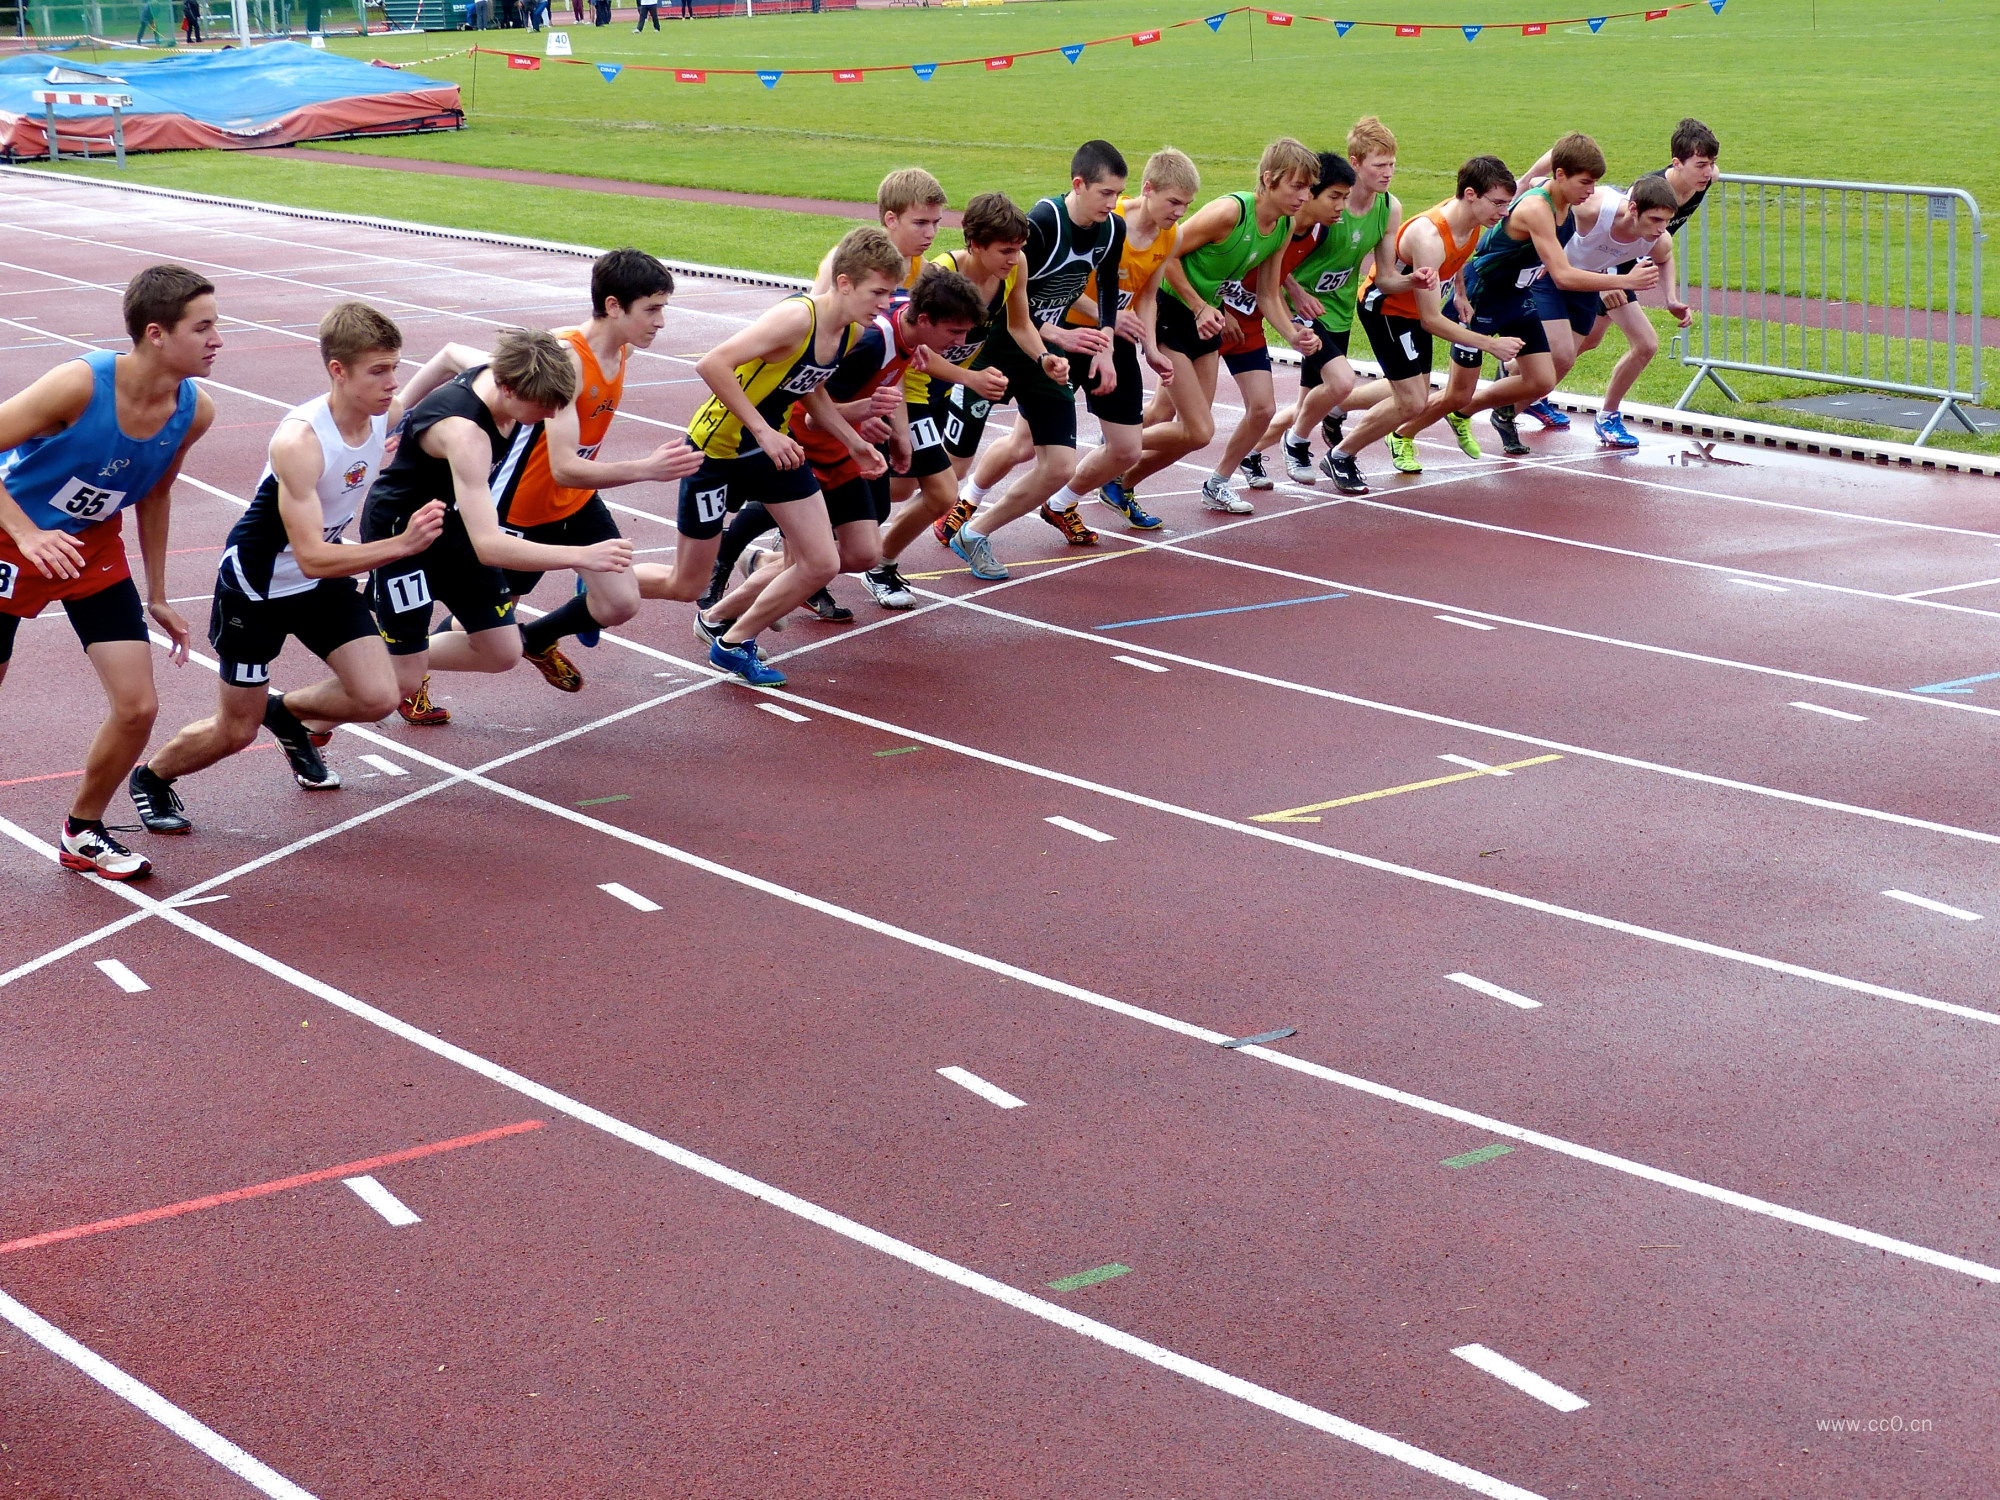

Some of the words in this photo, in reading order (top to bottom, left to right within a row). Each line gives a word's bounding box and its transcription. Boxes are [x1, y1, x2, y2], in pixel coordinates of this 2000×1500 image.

[555, 34, 567, 44] 40
[600, 66, 617, 74] DIMA
[991, 58, 1007, 66] DIMA
[1317, 271, 1350, 290] 257
[911, 419, 936, 446] 11
[65, 486, 112, 517] 55
[701, 487, 725, 518] 13
[393, 573, 424, 607] 17
